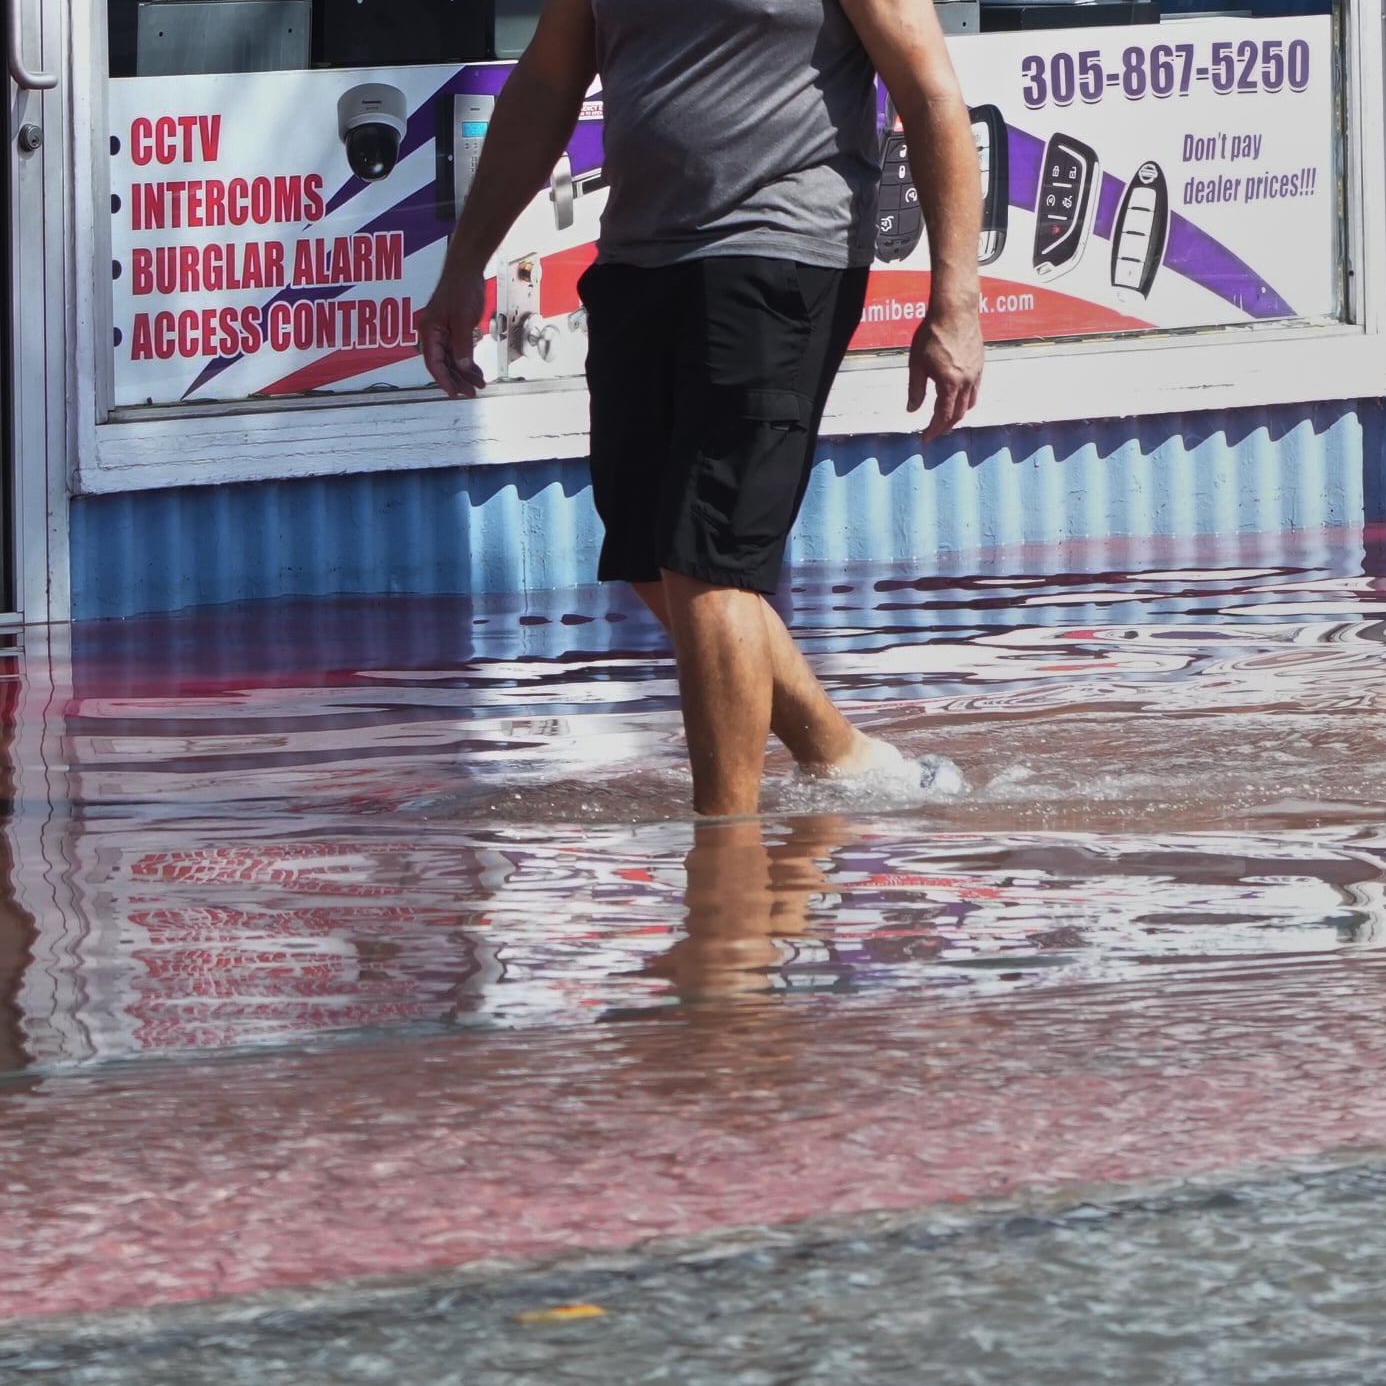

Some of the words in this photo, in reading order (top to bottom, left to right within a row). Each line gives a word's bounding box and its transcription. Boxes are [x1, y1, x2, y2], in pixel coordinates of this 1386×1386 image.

[1021, 39, 1310, 110] 305-867-5250
[130, 114, 222, 166] CCTV
[1182, 131, 1226, 162] Don't
[1230, 133, 1262, 162] pay
[131, 173, 325, 231] INTERCOMS
[1183, 175, 1242, 205] dealer
[1244, 167, 1317, 204] prices!!!
[131, 240, 285, 296] BURGLAR
[292, 232, 403, 286] ALARM
[131, 305, 261, 361] ACCESS
[270, 297, 418, 352] CONTROL
